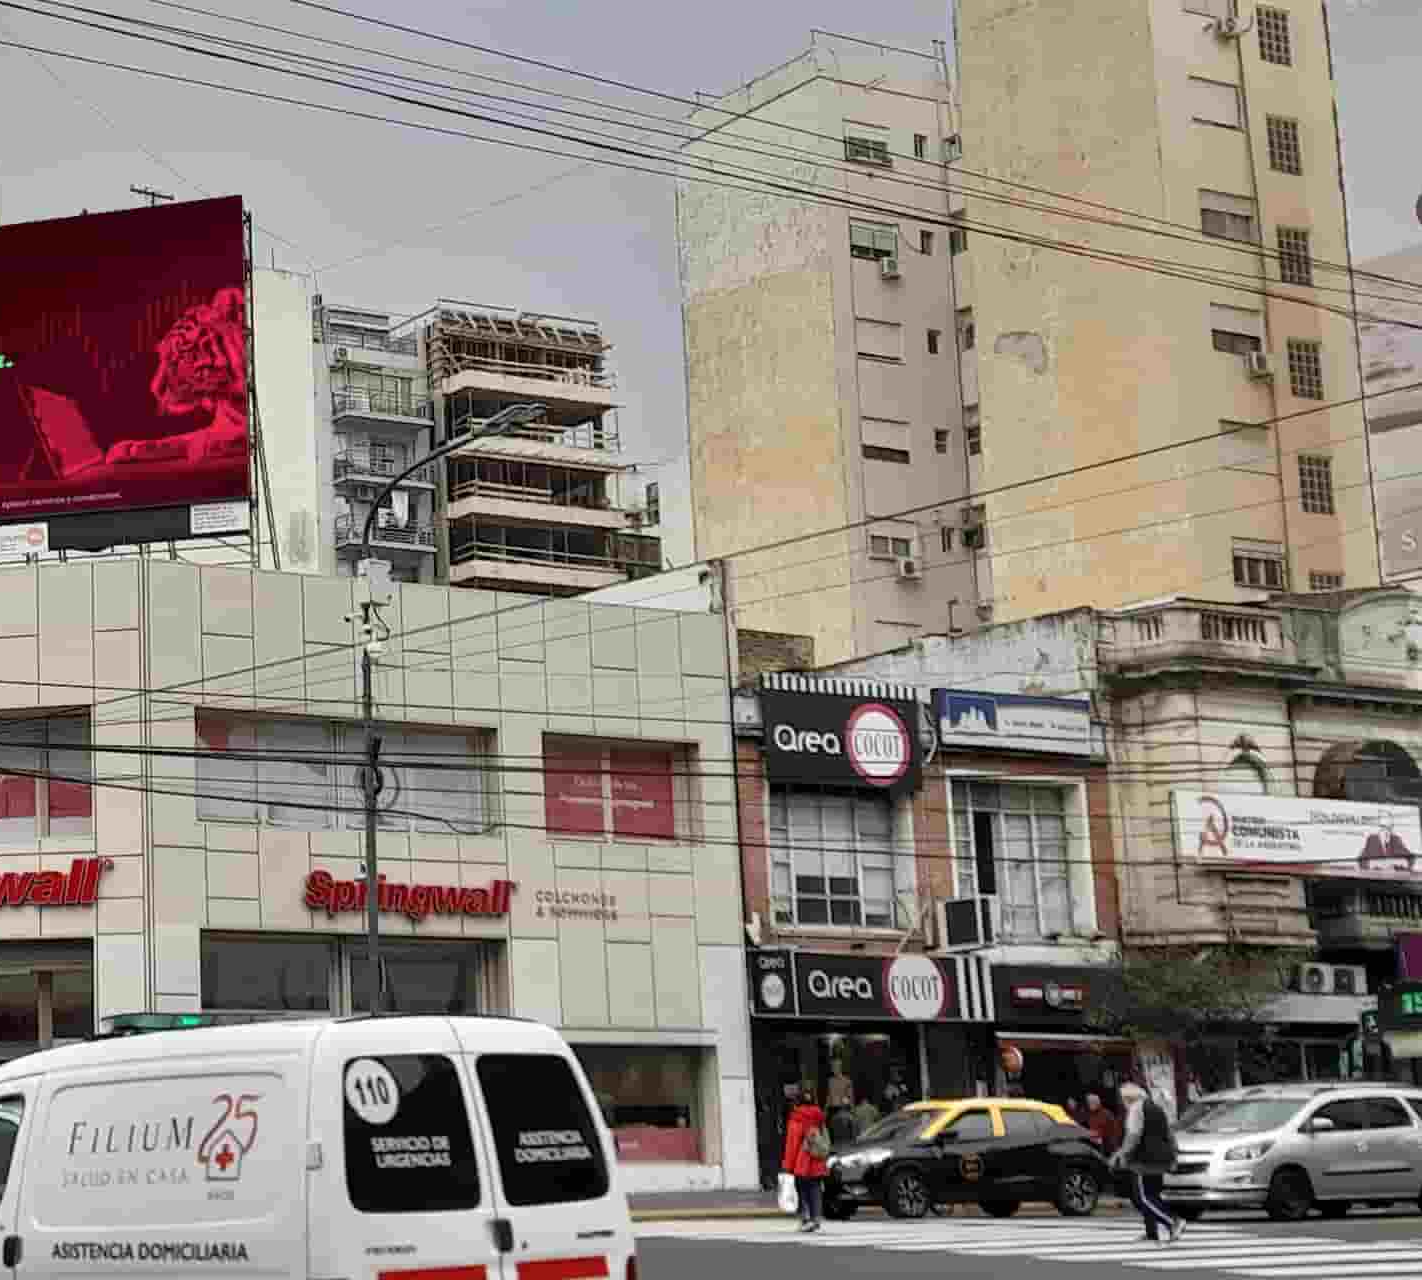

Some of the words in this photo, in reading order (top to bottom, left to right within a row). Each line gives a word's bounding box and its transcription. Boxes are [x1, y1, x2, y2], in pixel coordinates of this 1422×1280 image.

[855, 732, 900, 758] COCOT
[1233, 826, 1300, 841] COMUNISTA
[892, 975, 939, 1001] COCOT
[354, 1075, 390, 1105] 110
[67, 1114, 194, 1156] FILIUM
[198, 1093, 260, 1164] 25
[518, 1130, 584, 1146] ASISTENCIA
[371, 1135, 429, 1152] SERVICIO
[431, 1135, 450, 1151] DE
[514, 1145, 593, 1163] DOMICILIARIA
[375, 1151, 451, 1168] URGENCIAS
[60, 1167, 112, 1190] SALUD
[117, 1167, 139, 1185] EN
[145, 1166, 191, 1185] CASA
[51, 1241, 133, 1260] ASISTENCIA
[137, 1241, 250, 1262] DOMICILIARIA
